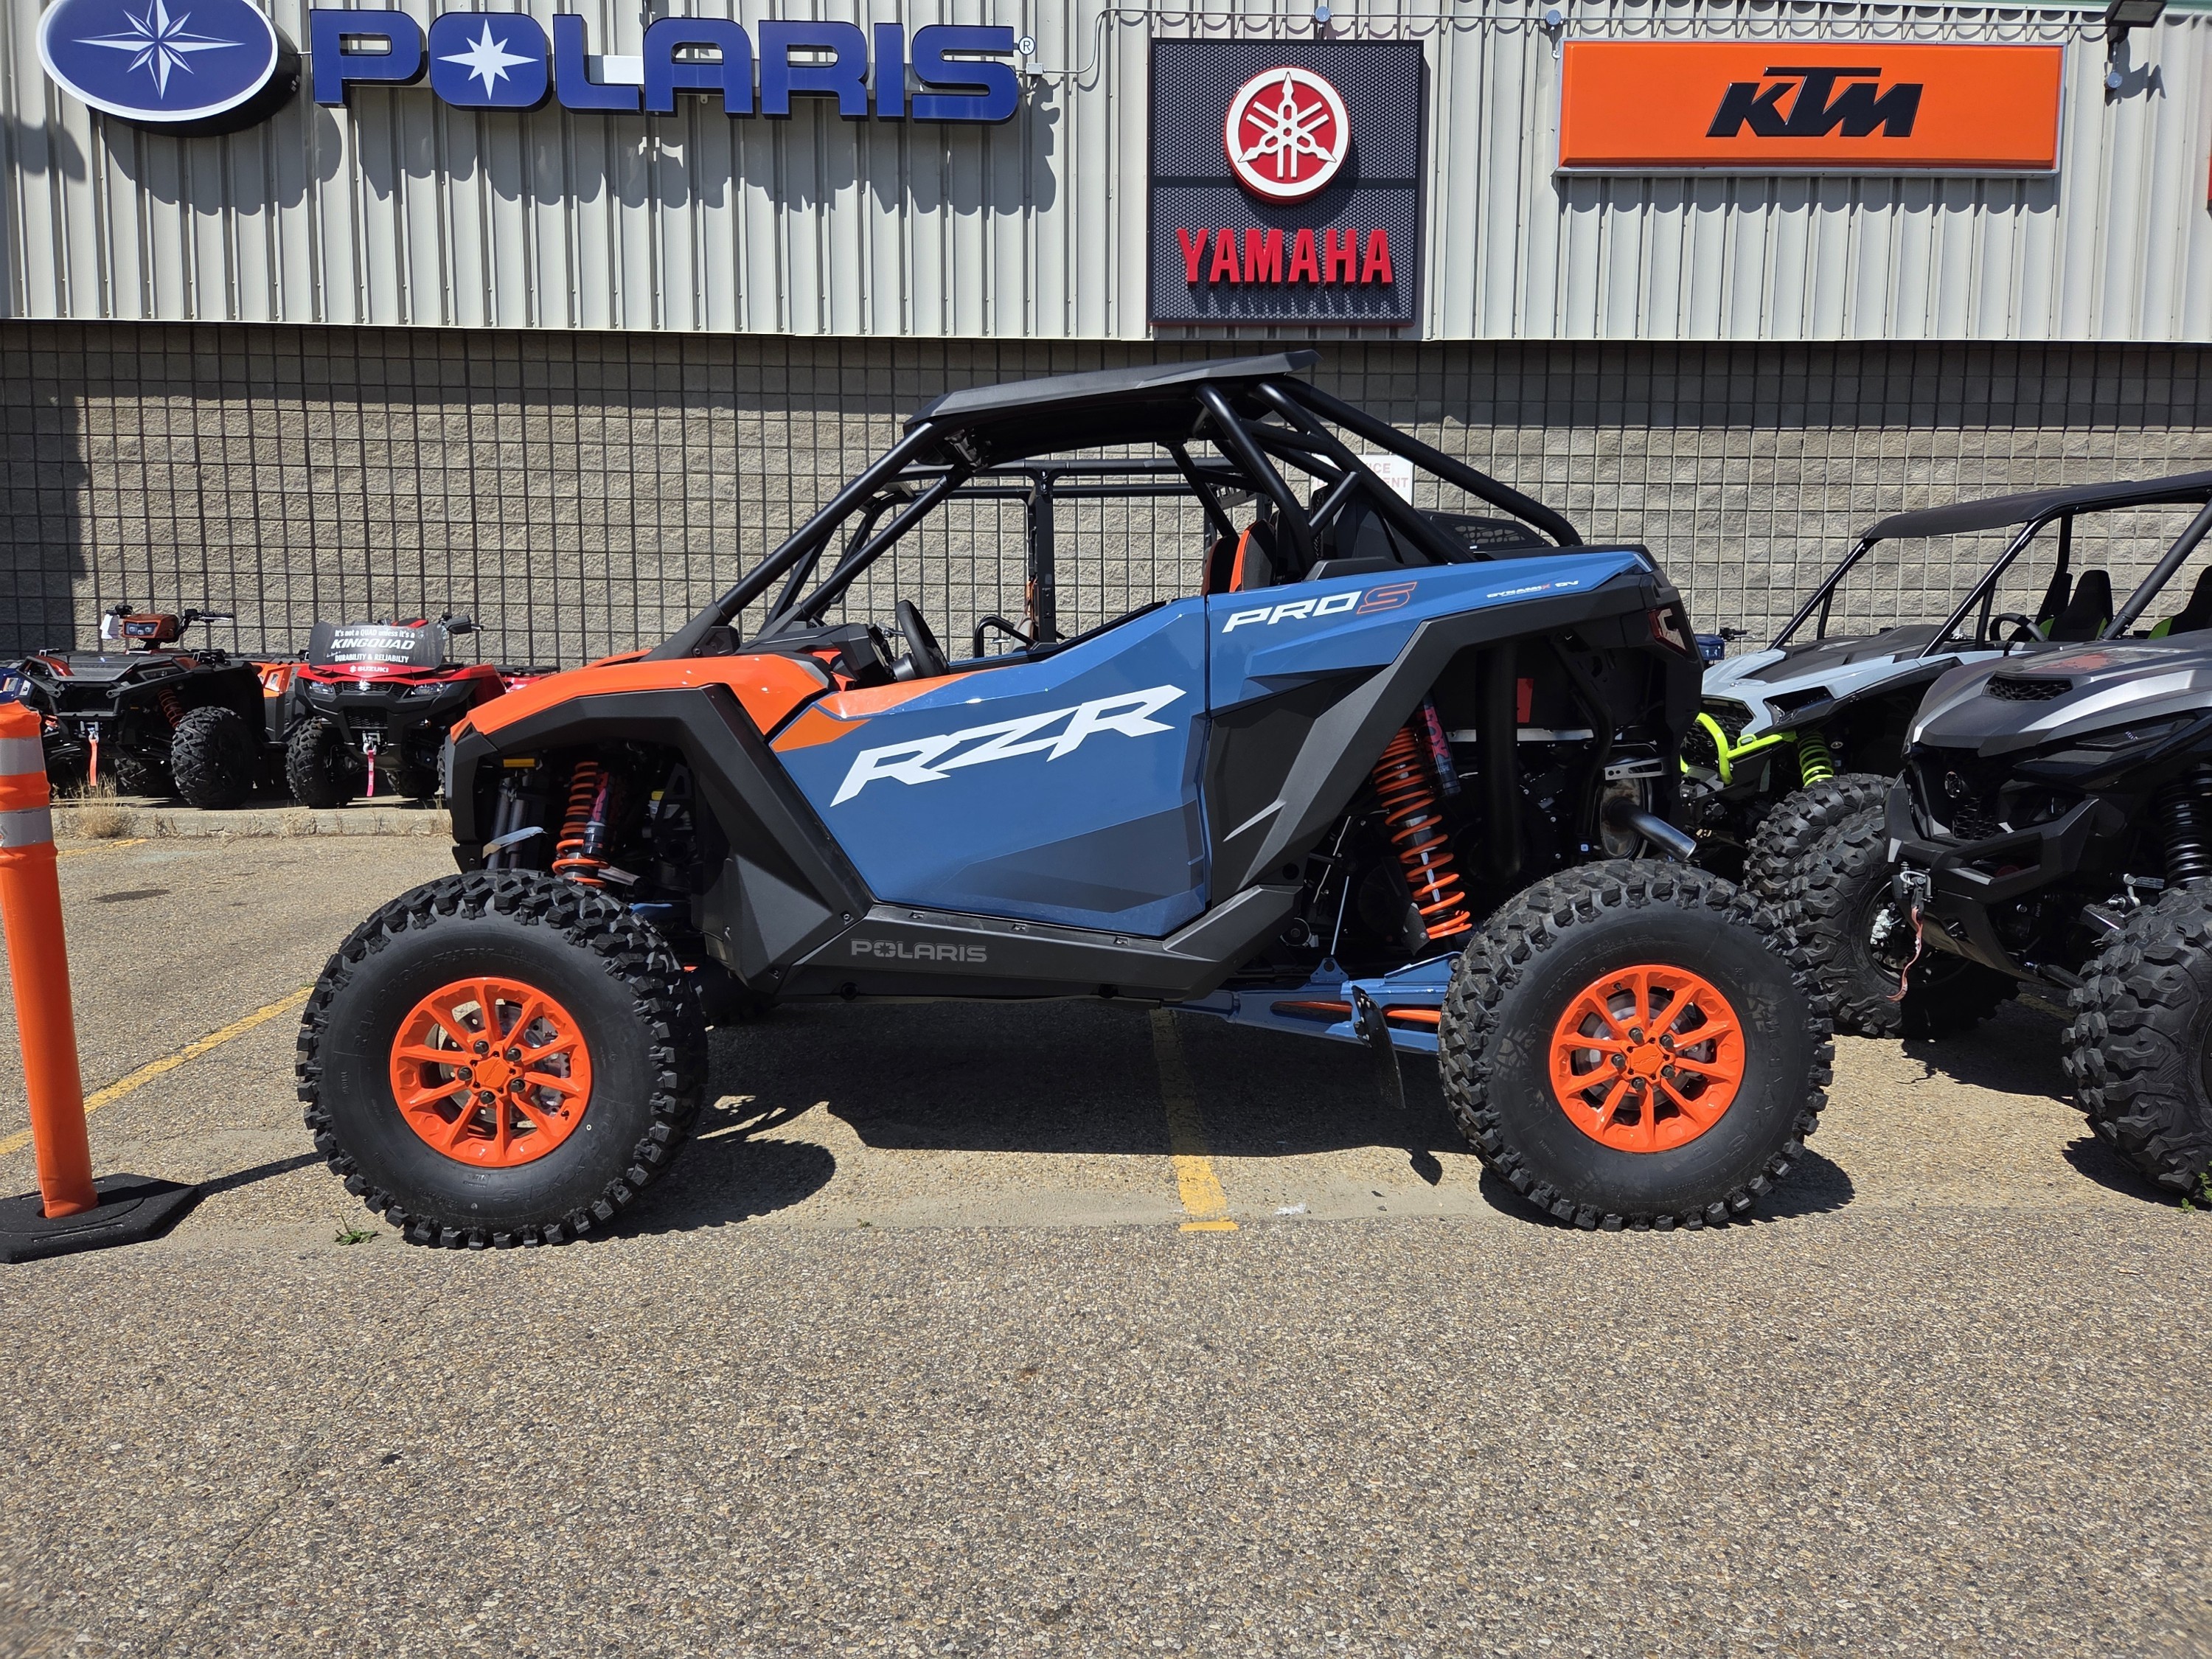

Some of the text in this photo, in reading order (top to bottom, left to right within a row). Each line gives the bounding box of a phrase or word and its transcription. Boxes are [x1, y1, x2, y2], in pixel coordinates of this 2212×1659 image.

[309, 9, 1019, 123] POLARIS
[1705, 66, 1924, 138] KTM
[1176, 228, 1394, 285] YAMAHA
[330, 639, 415, 650] KINGQUAD
[335, 653, 366, 662] DURABILITY
[830, 684, 1187, 807] RZR
[851, 939, 987, 962] POLARIS
